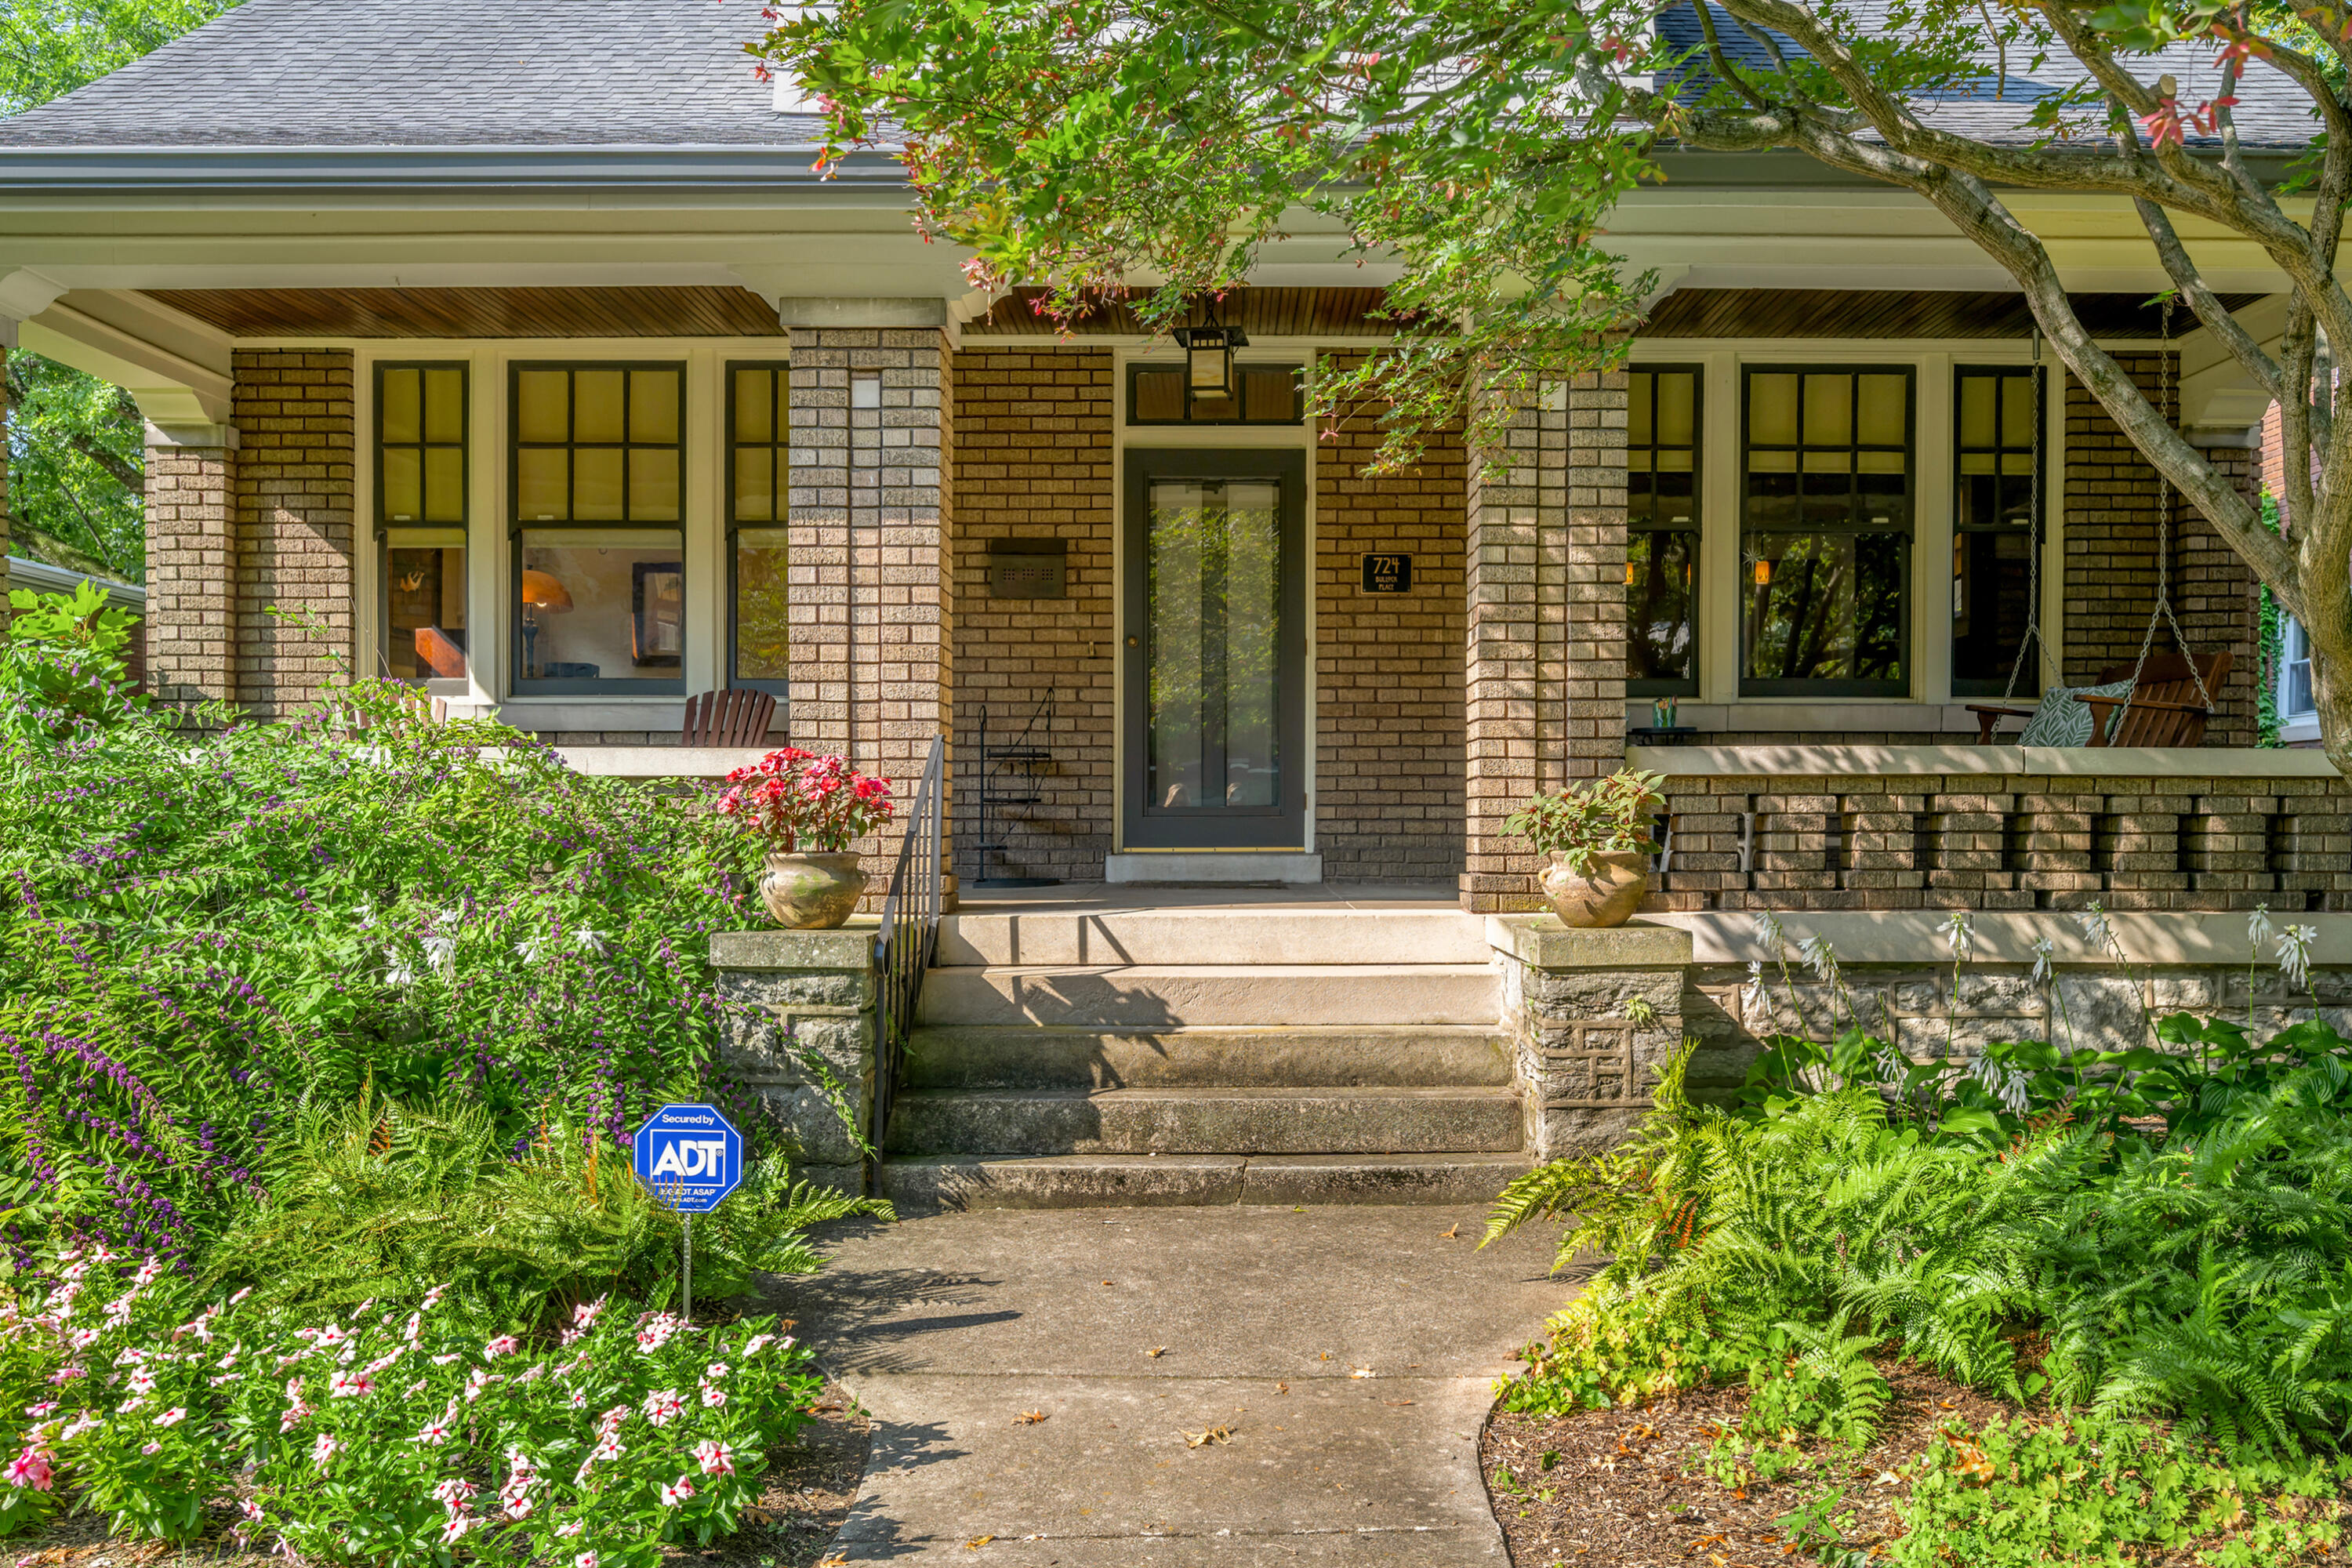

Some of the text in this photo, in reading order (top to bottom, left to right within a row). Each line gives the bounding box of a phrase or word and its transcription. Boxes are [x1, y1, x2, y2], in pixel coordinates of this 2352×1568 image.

[1374, 557, 1400, 574] 724
[662, 1114, 714, 1126] Secured by
